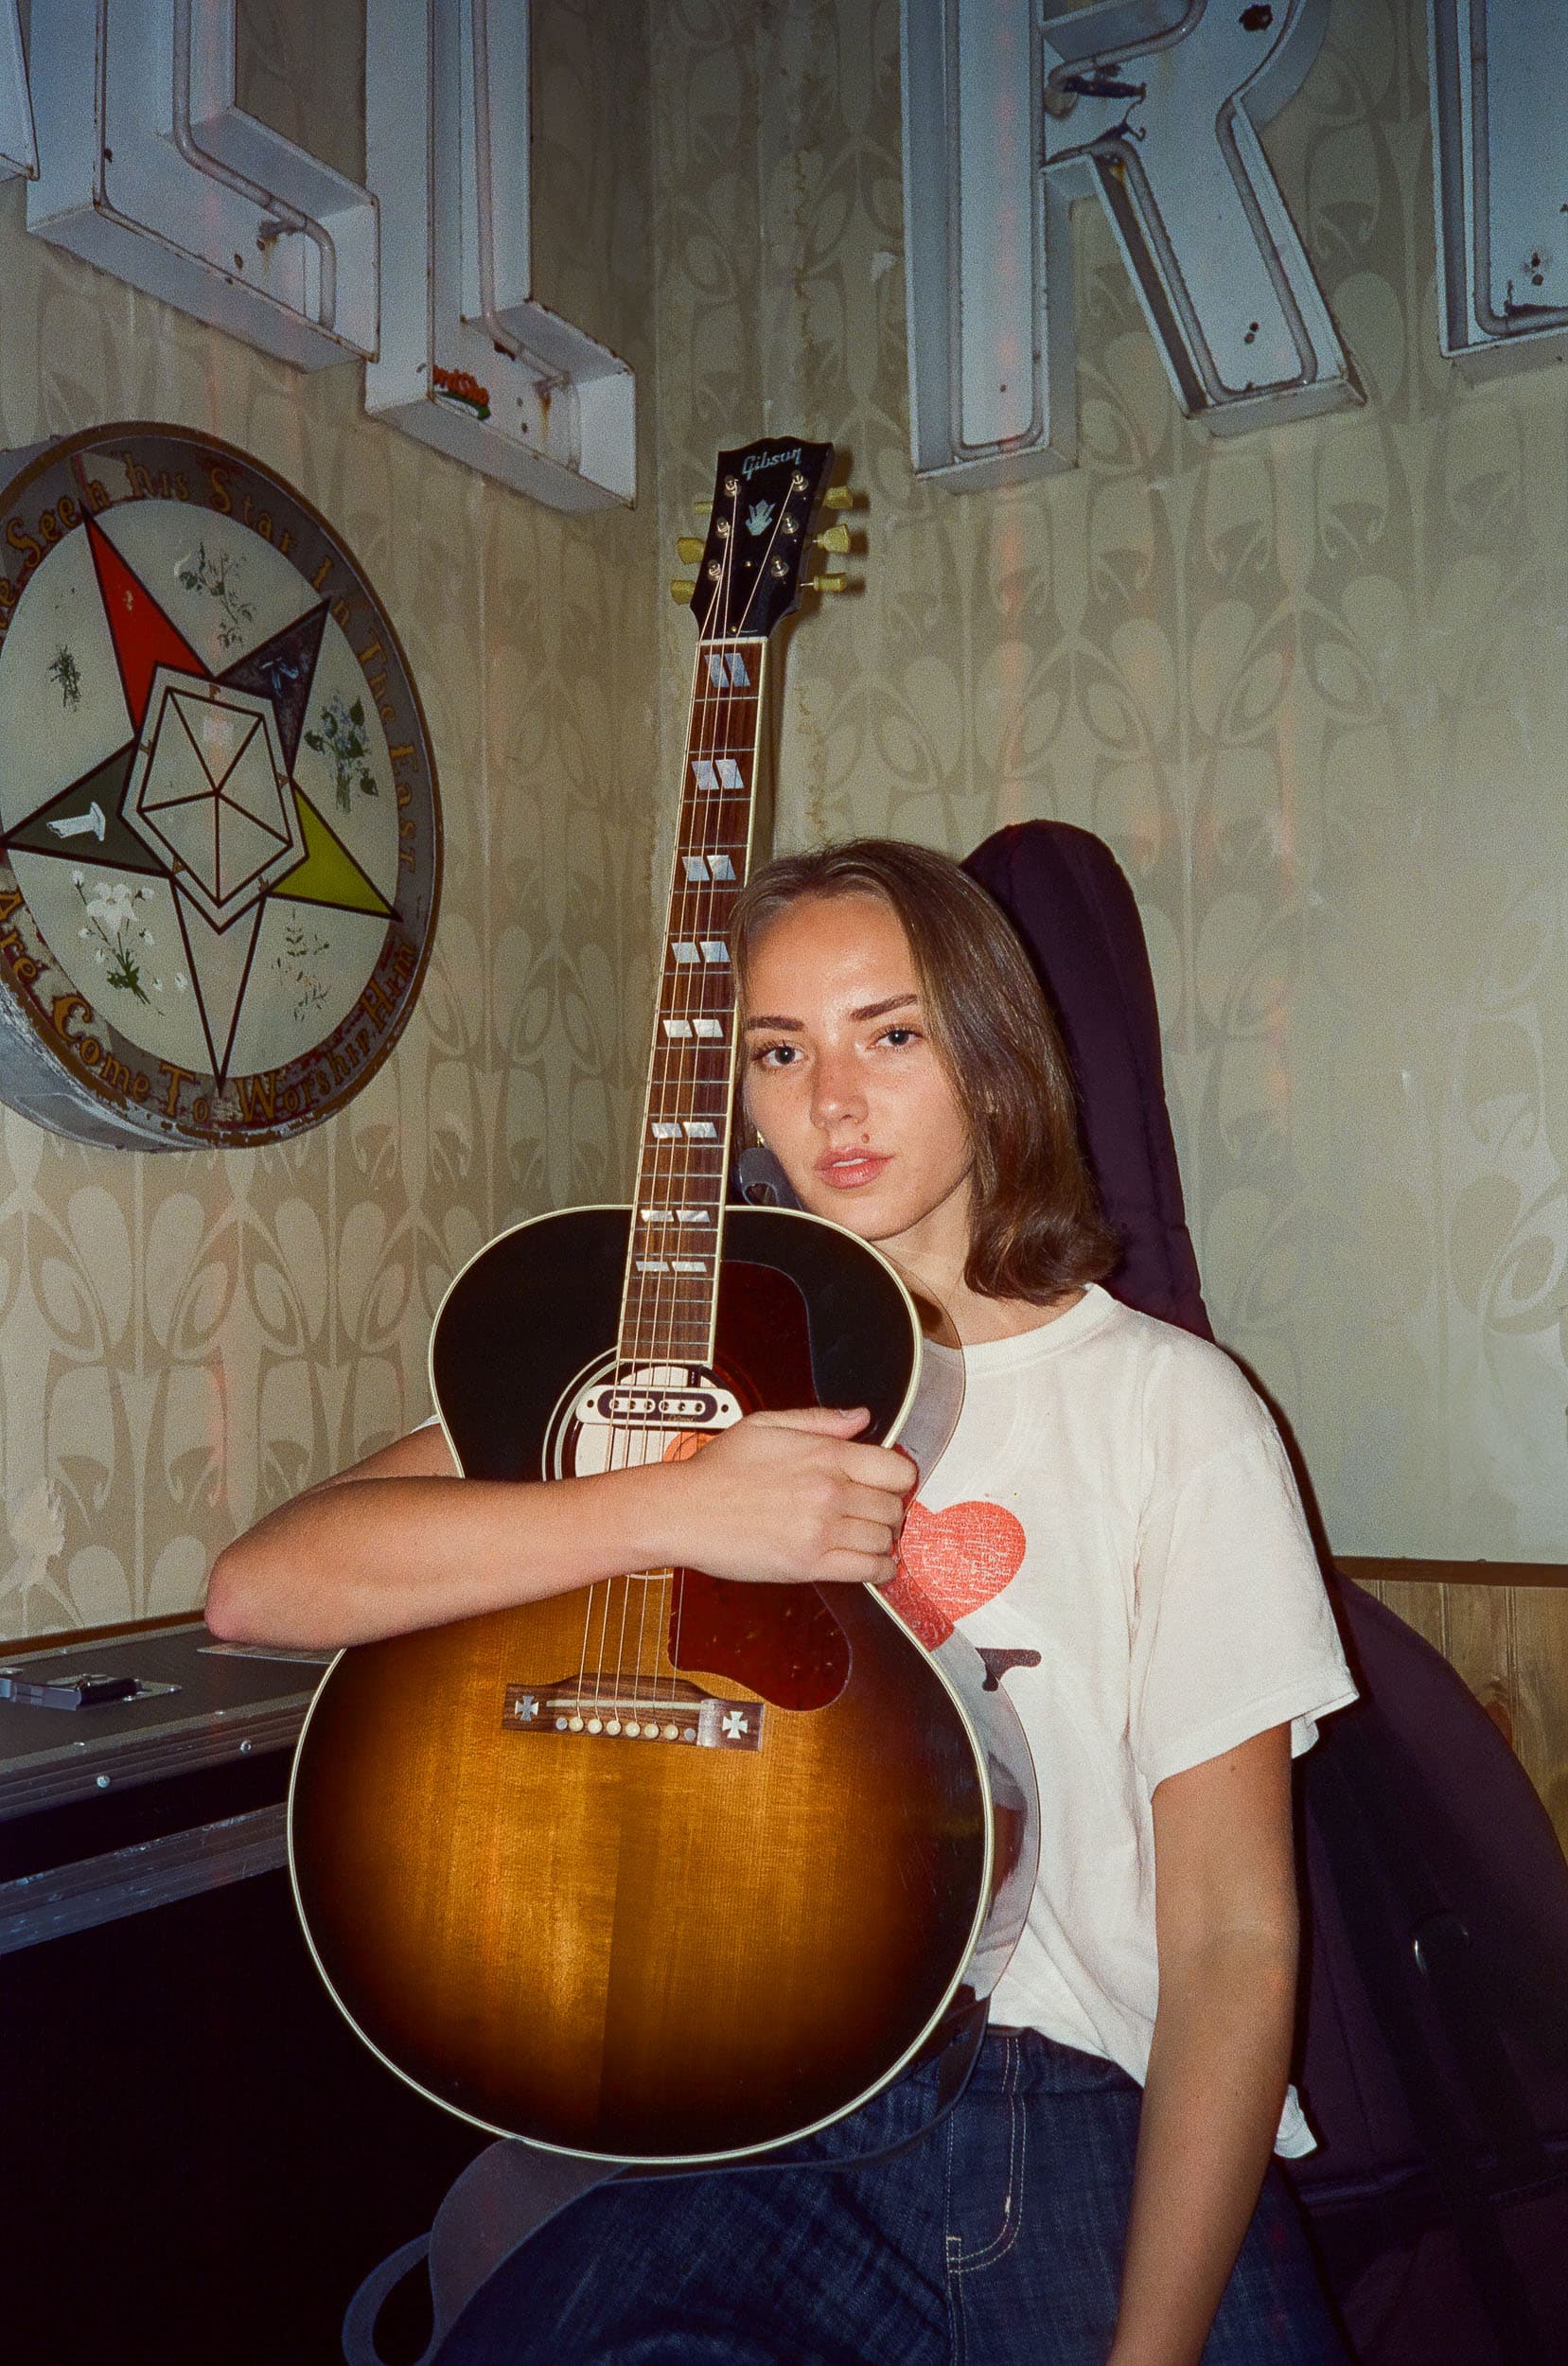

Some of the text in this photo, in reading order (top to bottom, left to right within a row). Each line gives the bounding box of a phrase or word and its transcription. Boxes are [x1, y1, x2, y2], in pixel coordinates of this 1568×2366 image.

[743, 448, 802, 481] Gibson
[6, 479, 112, 568] Seen
[210, 468, 298, 554] Star
[313, 557, 348, 626] In
[359, 627, 396, 723] The
[53, 995, 150, 1101] Come
[159, 1062, 209, 1121] To
[234, 1029, 370, 1123] Worship
[359, 943, 416, 1033] Him
